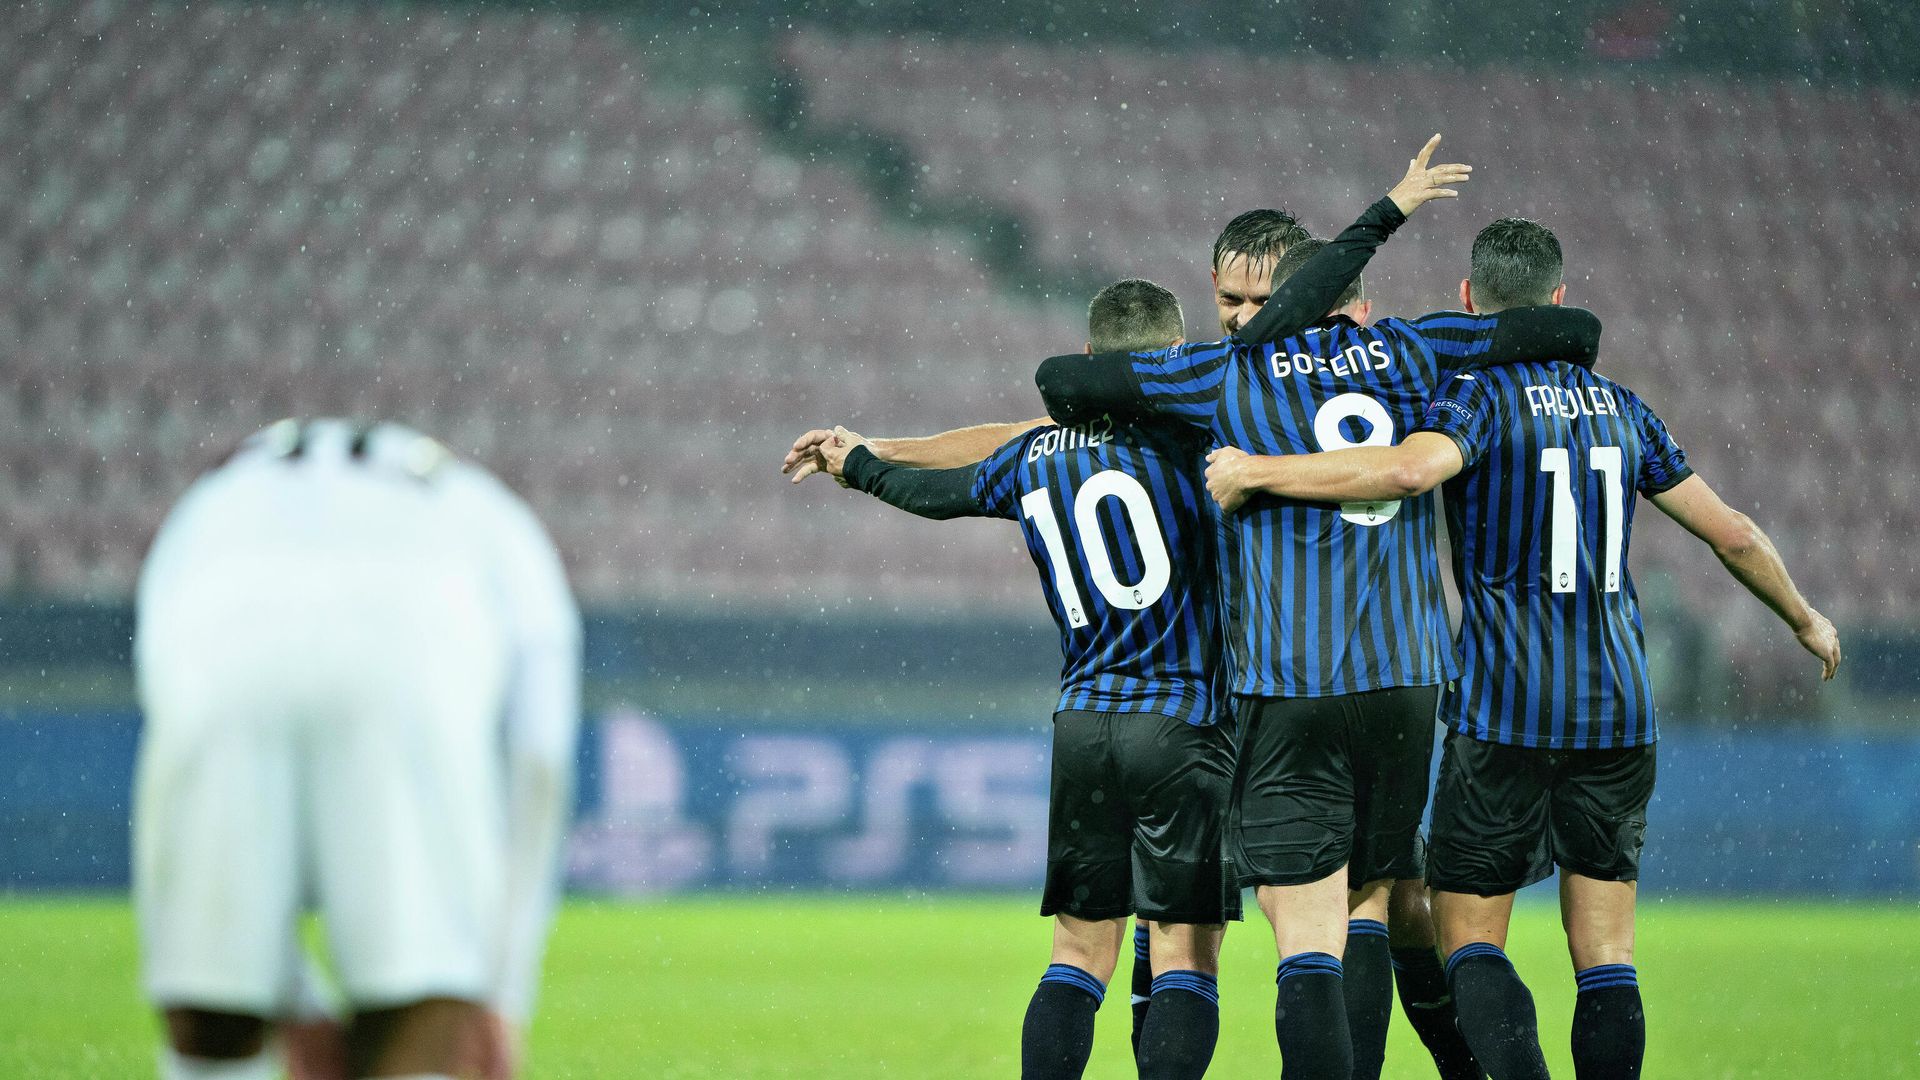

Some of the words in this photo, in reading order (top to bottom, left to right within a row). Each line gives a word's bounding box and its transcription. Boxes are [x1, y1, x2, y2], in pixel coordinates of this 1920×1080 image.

[1028, 413, 1114, 463] GOMEZ
[1435, 400, 1473, 420] RESPECT
[1021, 469, 1171, 629] 10
[1540, 446, 1623, 593] 11
[724, 732, 1051, 886] PS5
